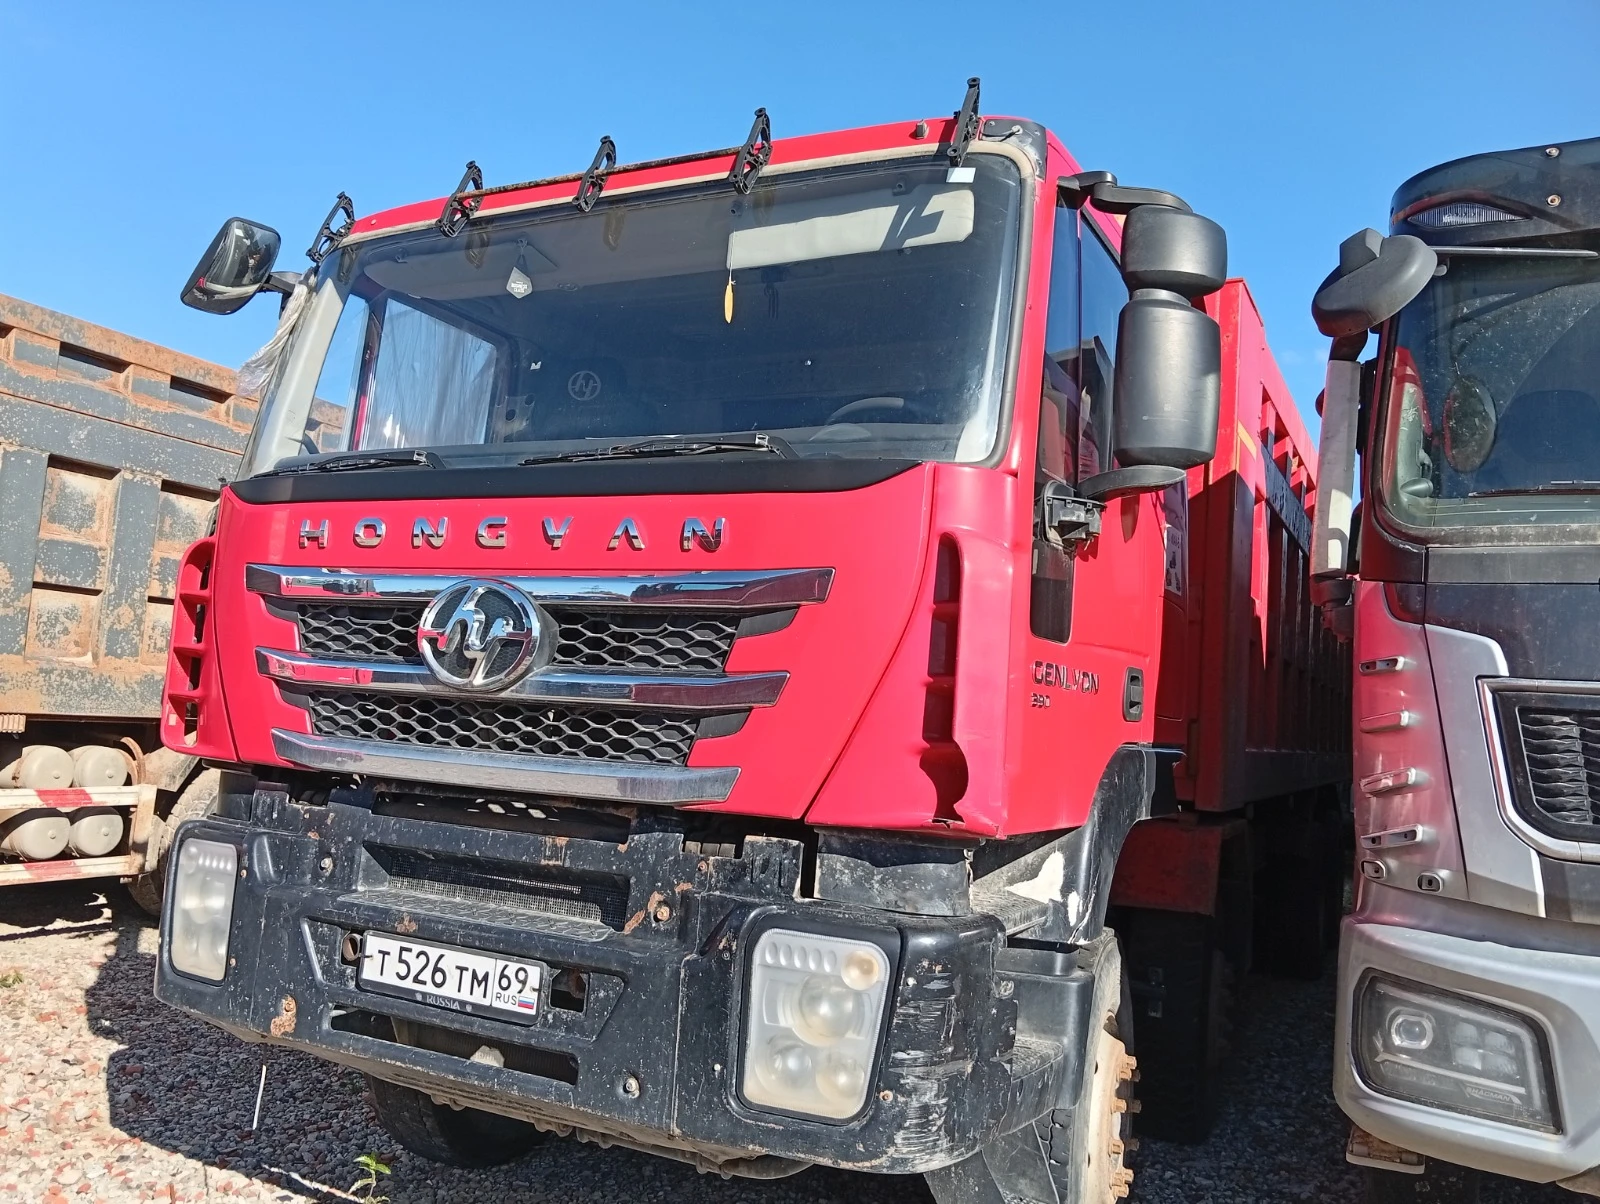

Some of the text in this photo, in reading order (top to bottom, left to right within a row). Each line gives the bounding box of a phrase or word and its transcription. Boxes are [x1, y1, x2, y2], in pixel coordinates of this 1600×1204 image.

[299, 516, 726, 552] HONGYAN
[497, 963, 530, 994] 69
[426, 994, 461, 1011] RUSSIA
[494, 991, 518, 1007] RUS
